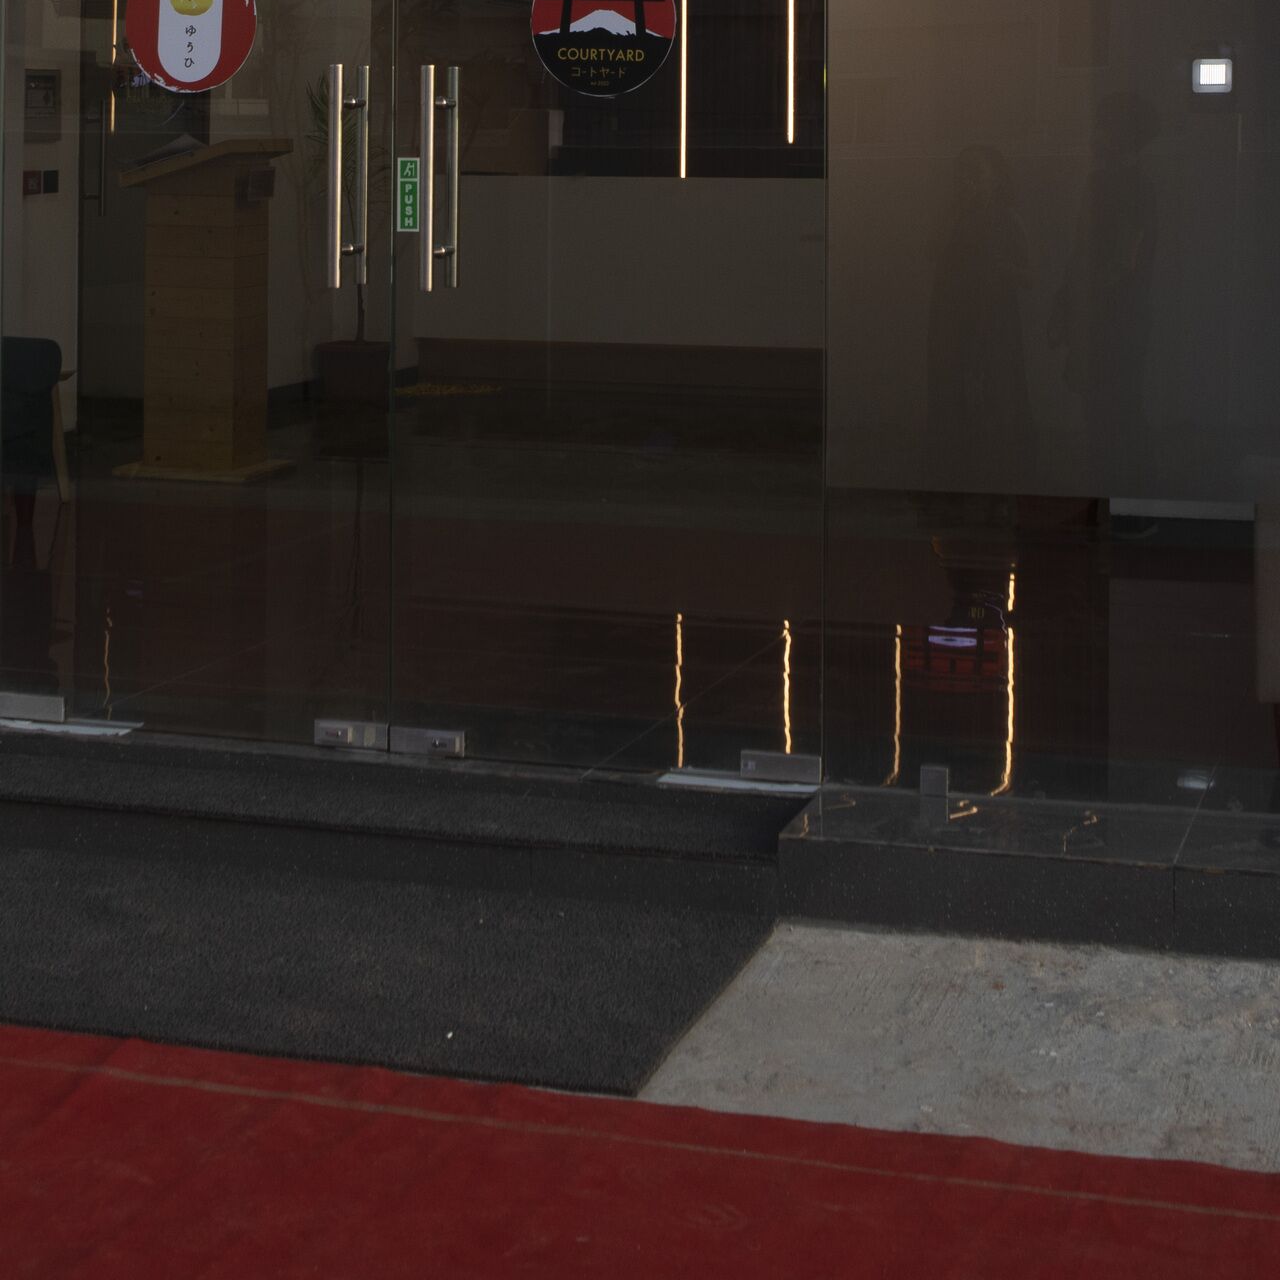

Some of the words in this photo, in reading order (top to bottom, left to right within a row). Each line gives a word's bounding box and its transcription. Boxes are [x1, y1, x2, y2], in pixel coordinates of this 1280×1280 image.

[184, 24, 197, 68] ゆうひ
[557, 47, 645, 62] COURTYARD
[404, 183, 414, 227] PUSH
